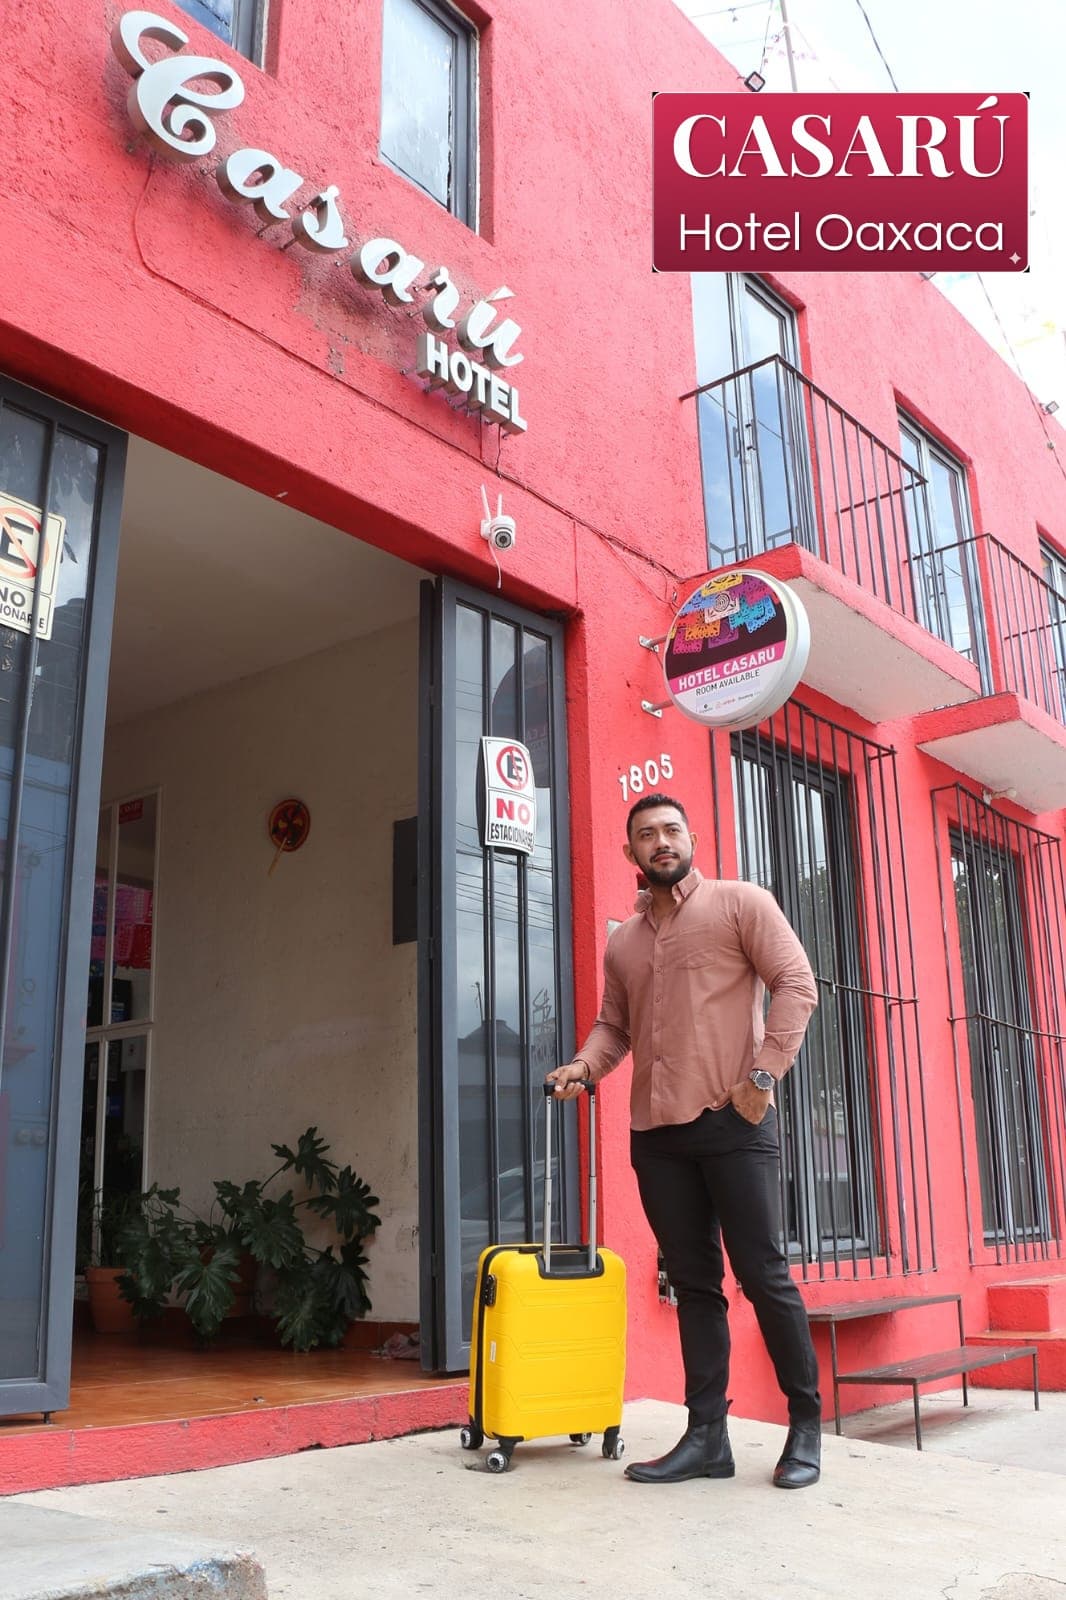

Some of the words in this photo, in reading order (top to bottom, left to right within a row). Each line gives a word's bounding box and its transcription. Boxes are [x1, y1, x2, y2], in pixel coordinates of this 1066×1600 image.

[112, 10, 524, 368] Casarú
[421, 334, 528, 434] HOTEL
[678, 667, 721, 691] HOTEL
[723, 647, 776, 676] CASARU
[695, 683, 718, 697] ROOM
[719, 669, 760, 689] AVAILABLE
[618, 753, 674, 801] 1805
[496, 798, 531, 825] NO
